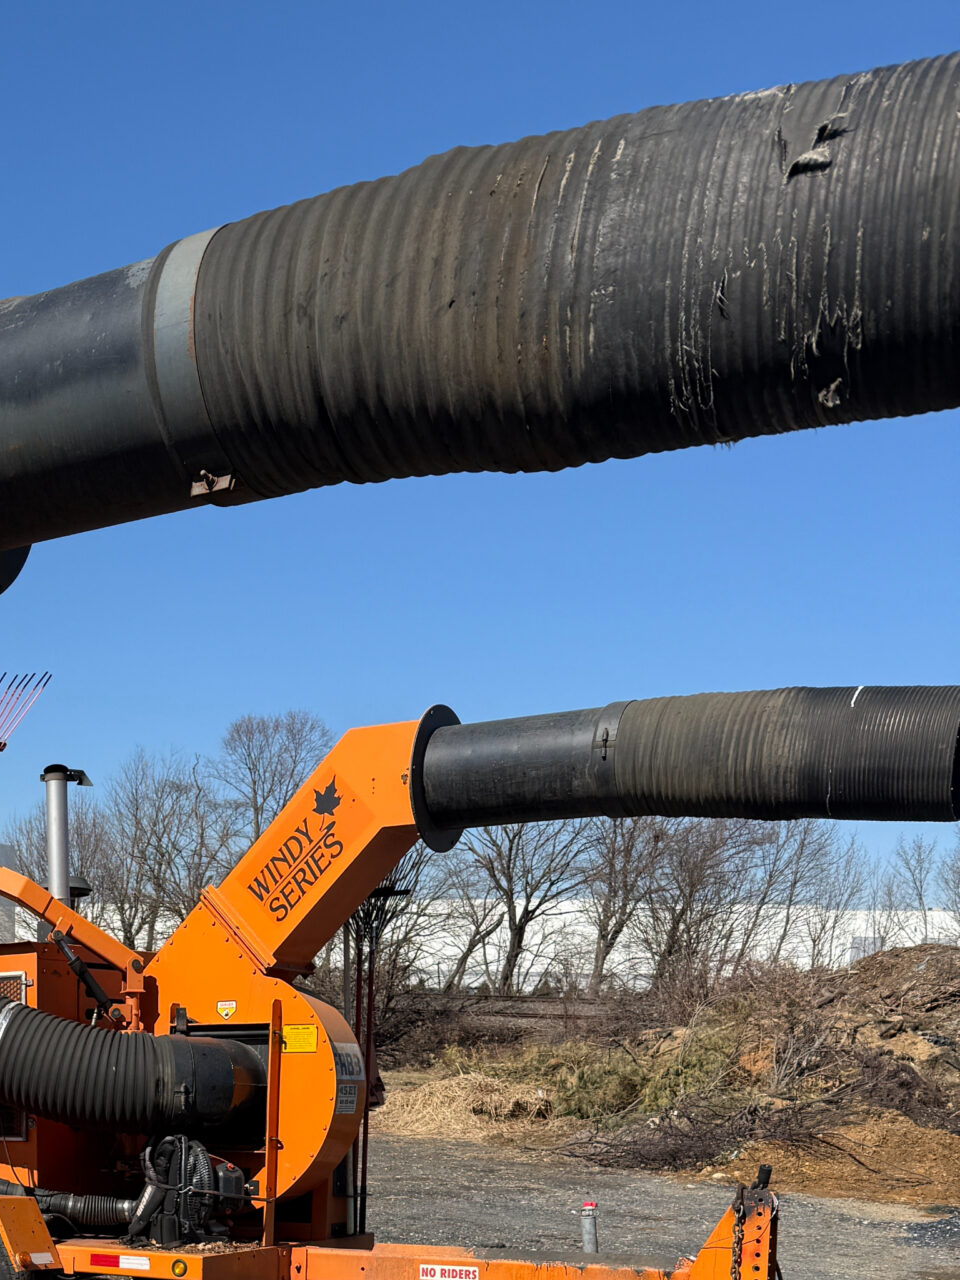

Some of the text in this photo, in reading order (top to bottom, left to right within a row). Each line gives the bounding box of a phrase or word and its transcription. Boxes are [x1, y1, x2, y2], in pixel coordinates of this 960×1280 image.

[247, 817, 314, 902] WINDY
[269, 833, 344, 922] SERIES
[421, 1267, 477, 1280] NO RIDERS
